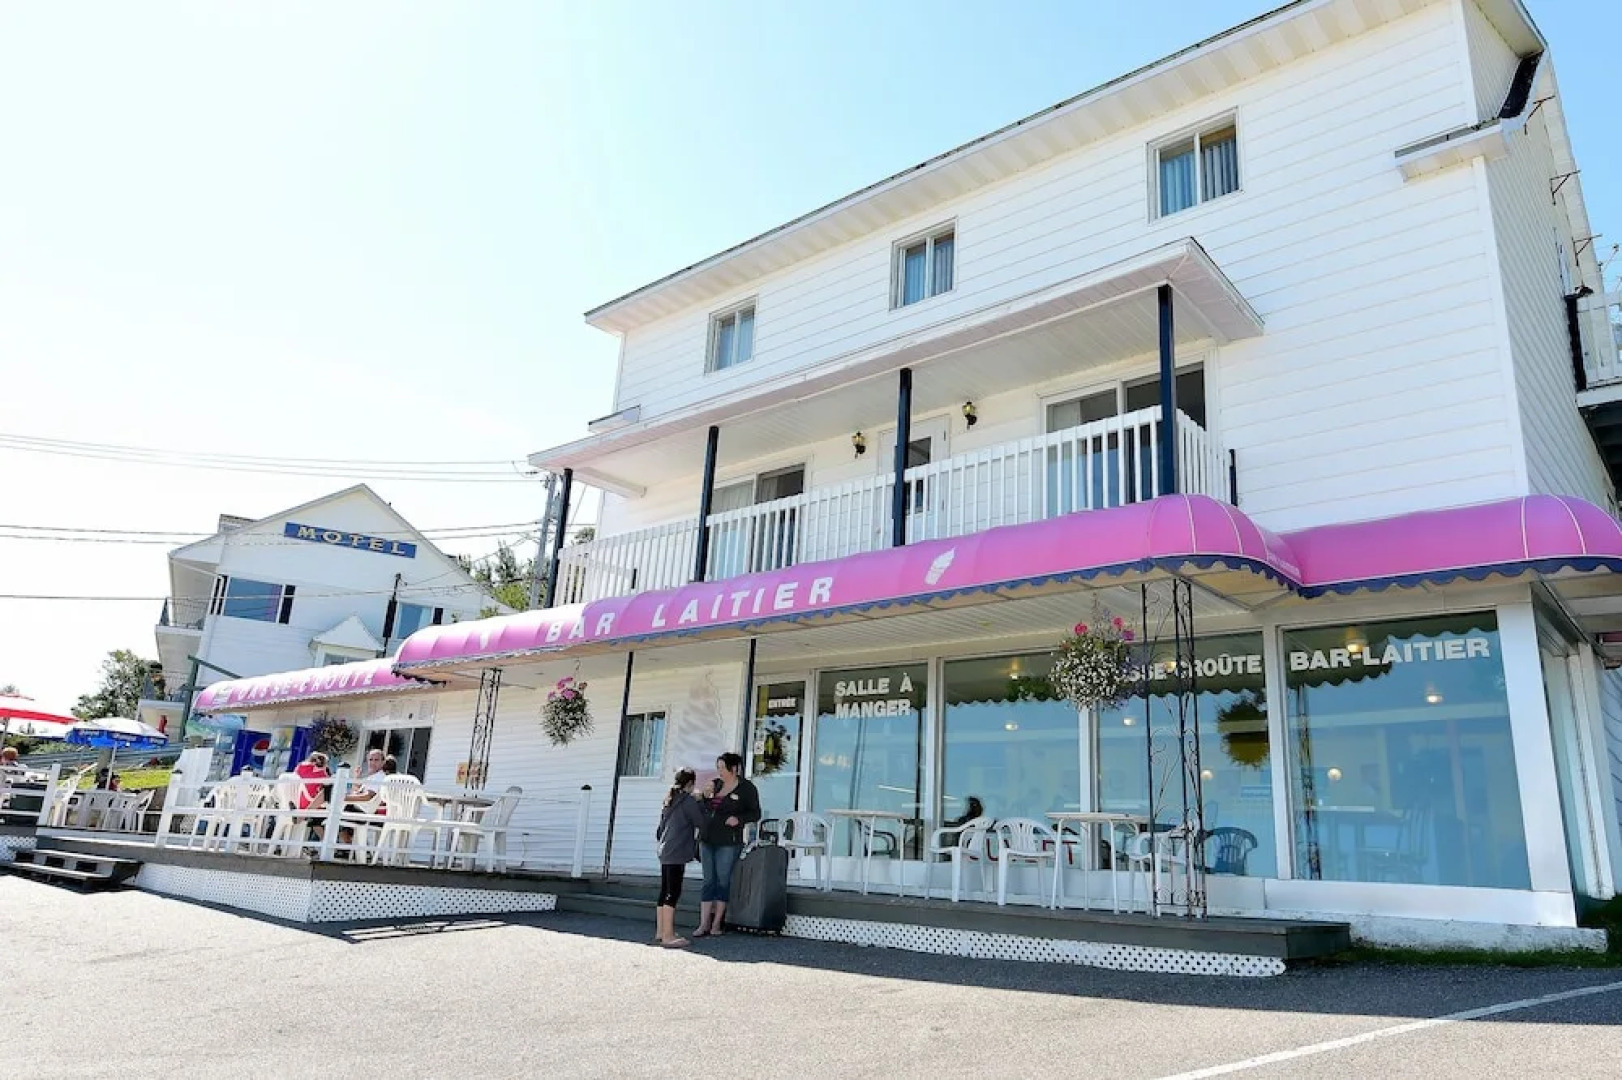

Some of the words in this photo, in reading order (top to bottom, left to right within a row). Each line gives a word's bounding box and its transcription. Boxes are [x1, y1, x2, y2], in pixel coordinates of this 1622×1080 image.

[297, 526, 405, 554] MOTEL
[545, 612, 616, 643] BAR
[651, 576, 833, 629] LAITIER
[1126, 653, 1261, 682] SSE-CROÛTE
[1290, 637, 1491, 671] BAR-LAITIER
[835, 677, 889, 697] SALLE
[900, 672, 913, 693] À
[836, 698, 911, 719] MANGER
